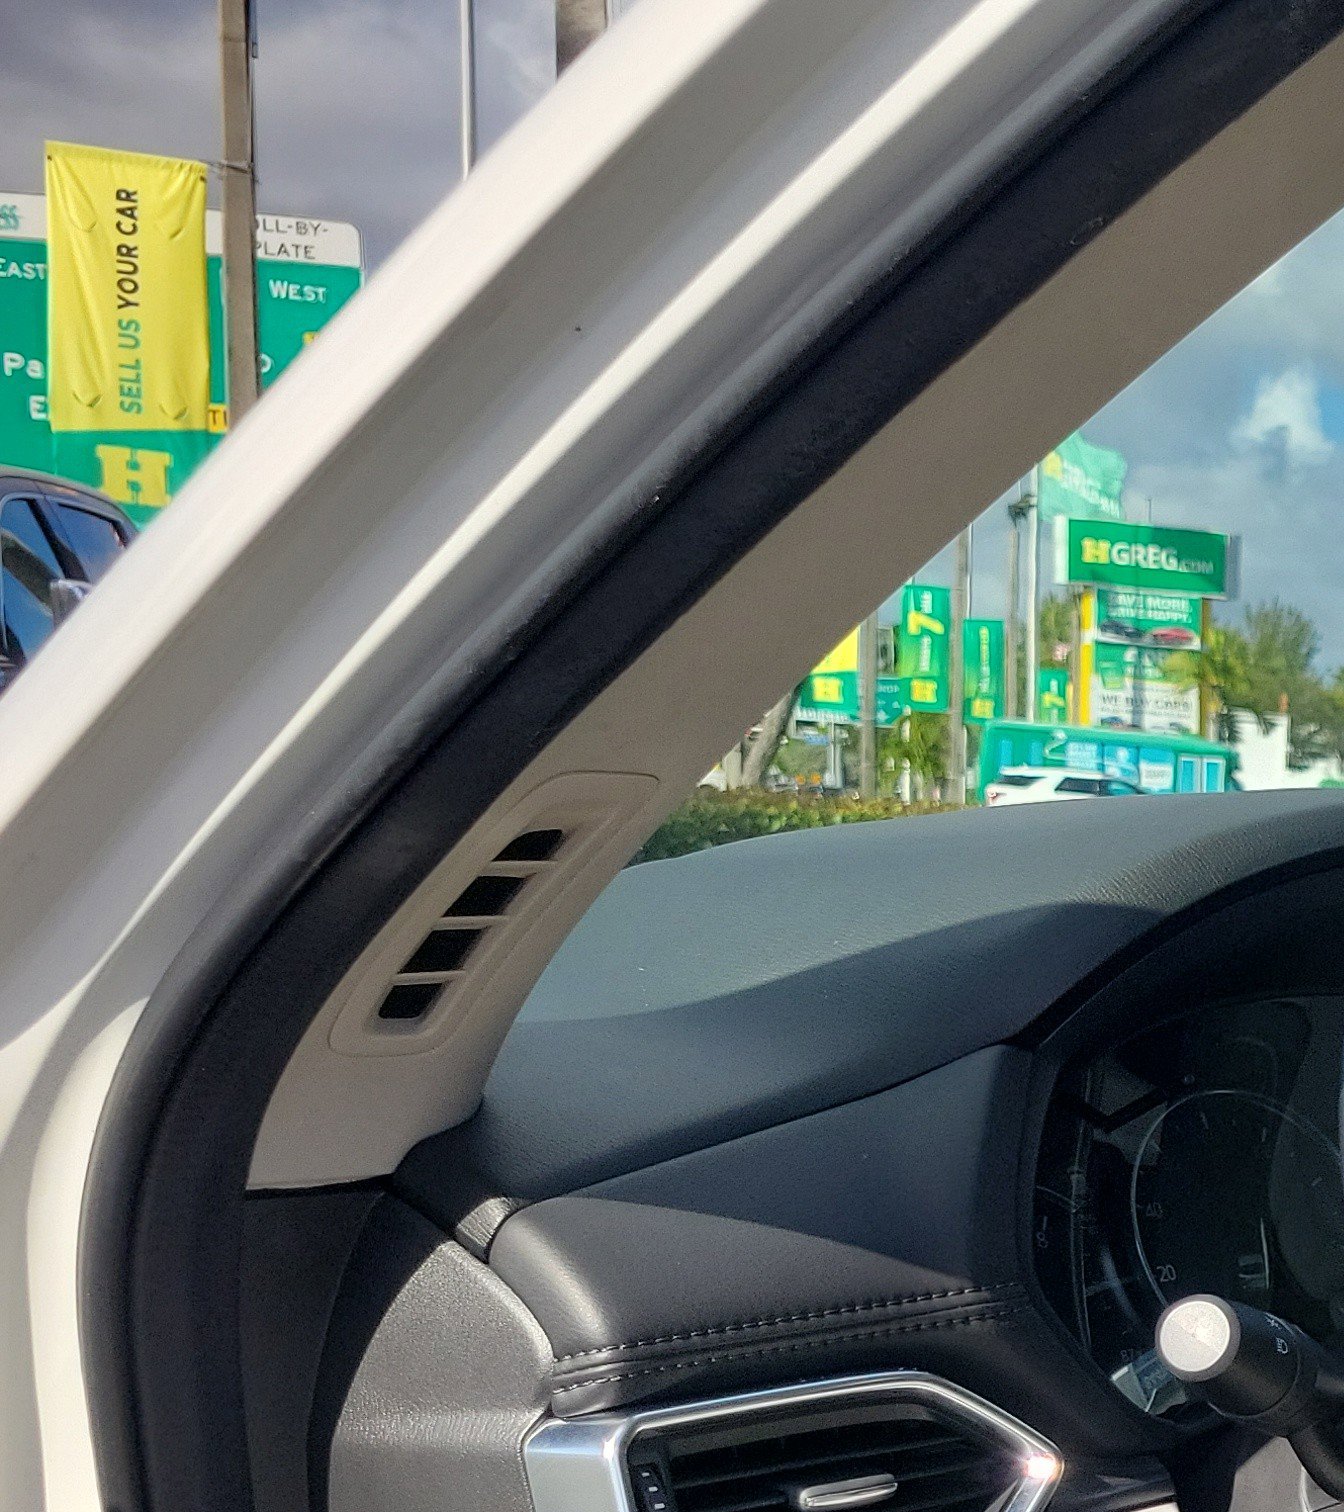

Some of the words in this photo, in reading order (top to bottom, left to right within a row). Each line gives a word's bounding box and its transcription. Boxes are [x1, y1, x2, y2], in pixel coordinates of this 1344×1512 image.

[115, 187, 139, 236] CAR
[116, 243, 140, 310] YOUR
[268, 278, 328, 303] WEST
[118, 318, 141, 351] US
[119, 359, 143, 415] SELL
[95, 444, 174, 508] H
[1156, 1264, 1177, 1283] 20
